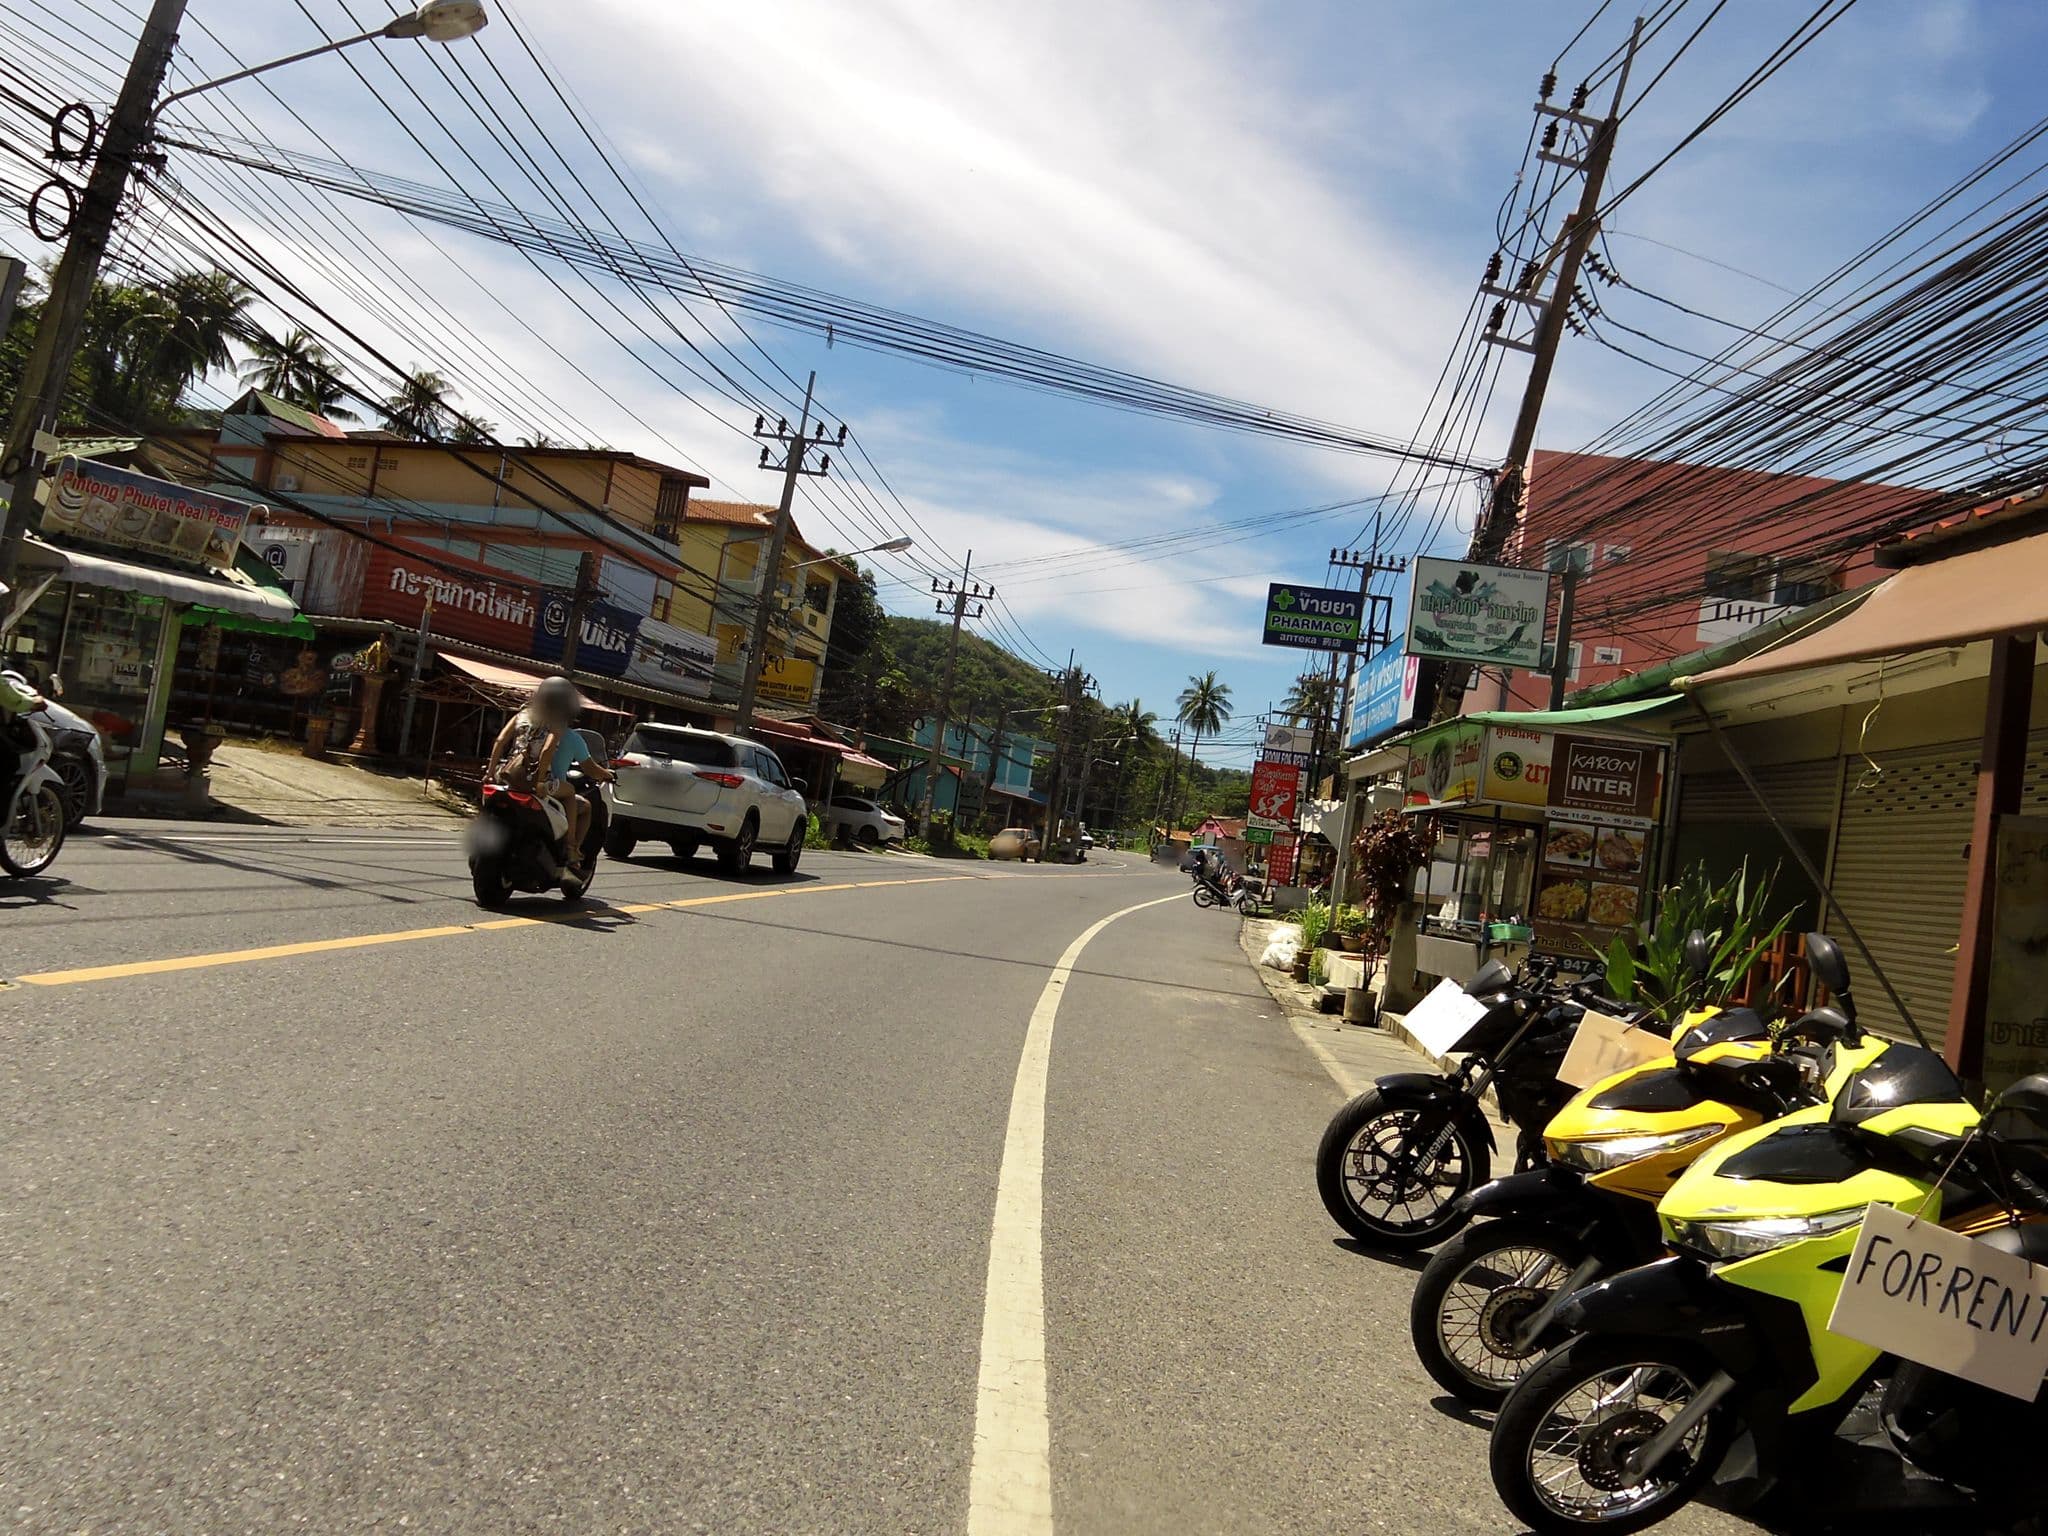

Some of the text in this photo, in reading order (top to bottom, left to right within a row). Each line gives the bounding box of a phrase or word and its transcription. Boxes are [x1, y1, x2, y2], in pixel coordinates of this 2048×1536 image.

[62, 469, 241, 529] Pintong Phuket Real Pearl
[265, 550, 284, 564] ICI
[1299, 597, 1356, 617] ขายยา
[563, 614, 631, 653] ulux
[1271, 614, 1353, 635] PHARMACY
[1571, 753, 1636, 772] KARON
[1570, 775, 1632, 797] INTER
[1562, 939, 1597, 952] Locl
[1563, 959, 1591, 972] 947
[1413, 1121, 1457, 1177] RIDGESTONE
